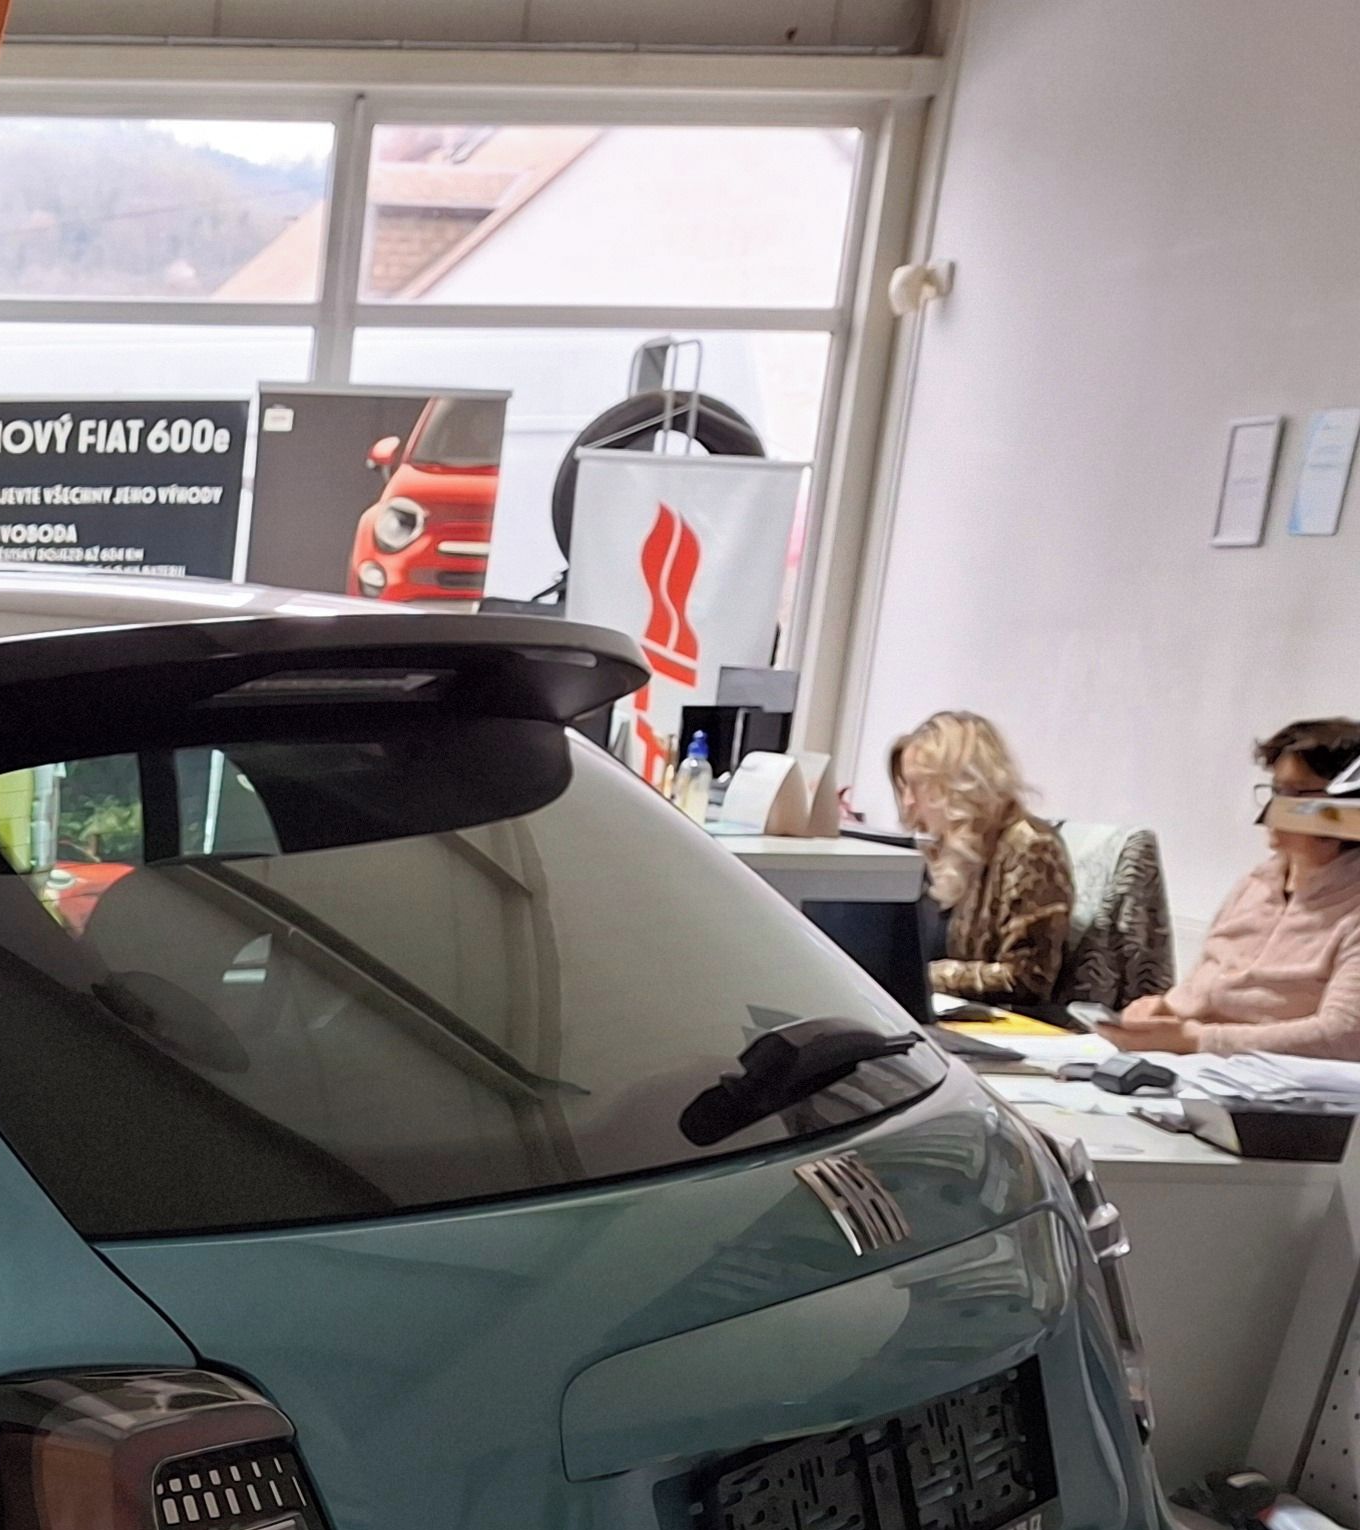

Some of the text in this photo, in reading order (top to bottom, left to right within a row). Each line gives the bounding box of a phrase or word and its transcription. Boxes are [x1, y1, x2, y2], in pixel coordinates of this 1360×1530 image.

[77, 418, 145, 454] FIAT
[146, 418, 230, 454] 600e
[43, 484, 113, 505] VŠECHNY
[112, 486, 157, 505] JEHO
